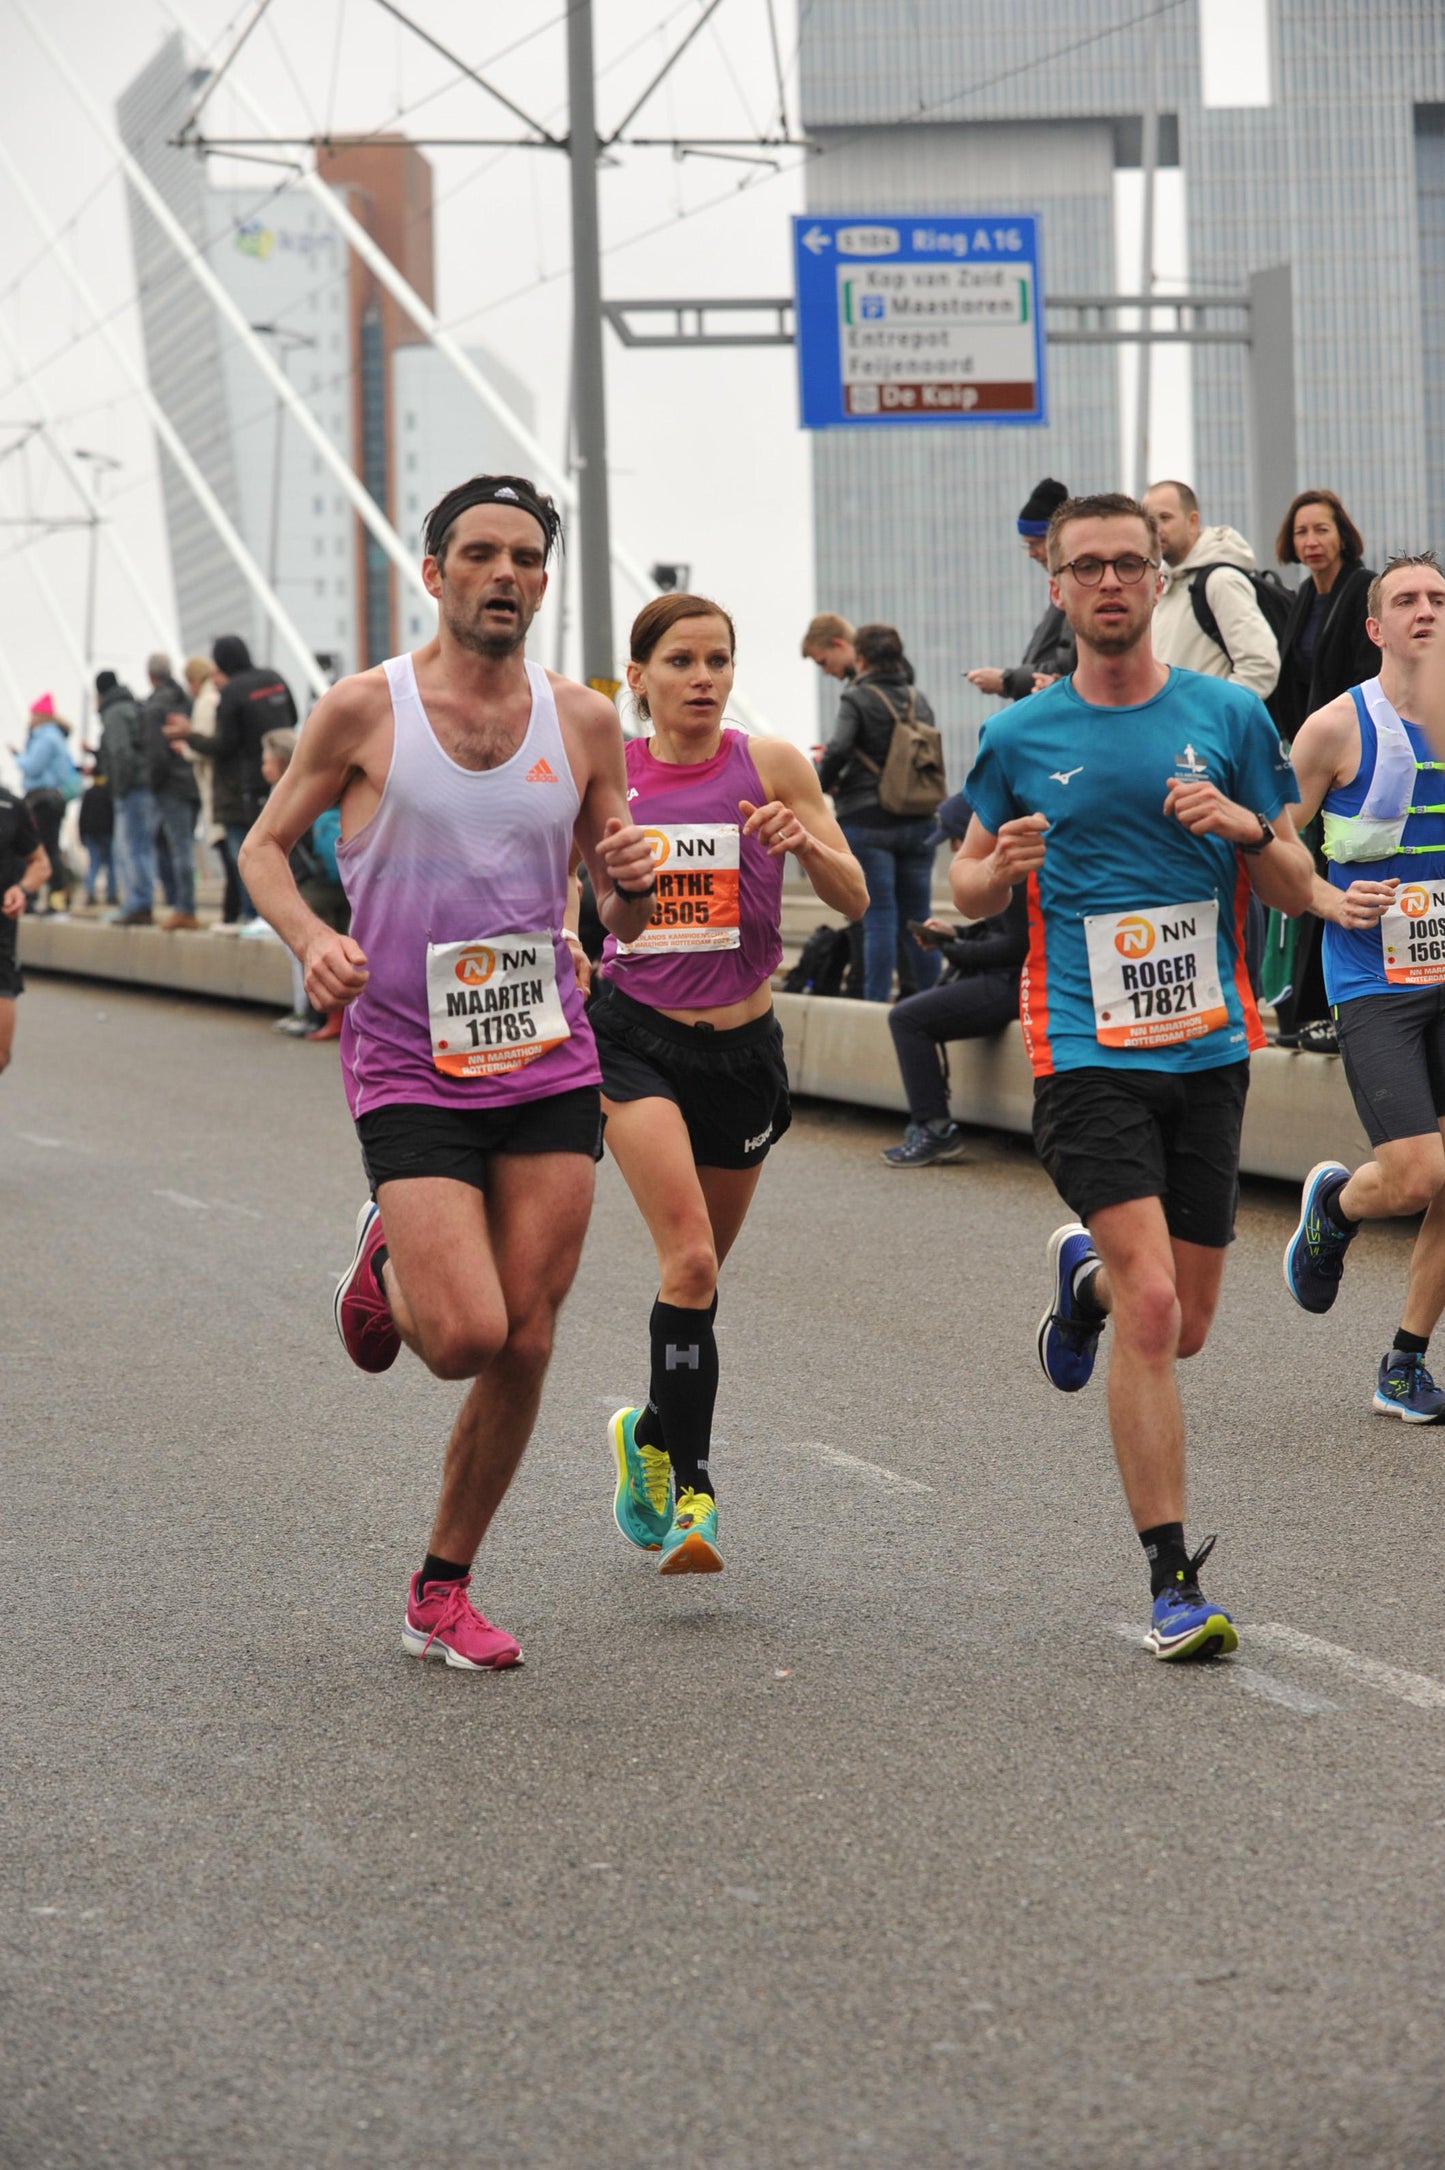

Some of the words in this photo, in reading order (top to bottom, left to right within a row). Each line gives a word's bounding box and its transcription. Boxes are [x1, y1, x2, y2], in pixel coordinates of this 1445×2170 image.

[912, 228, 968, 256] Ring
[867, 271, 906, 289] Kop
[913, 273, 949, 287] van
[958, 269, 1005, 287] Zuid
[891, 296, 1015, 315] Maastoren
[848, 330, 951, 350] Entrepot
[850, 353, 975, 379] Feijenoord
[882, 384, 916, 407] De
[921, 384, 979, 411] Kuip
[676, 839, 715, 857] NN
[655, 873, 714, 896] RTHE
[1161, 918, 1196, 943] NN
[502, 948, 536, 971] NN
[1121, 953, 1197, 991] ROGER
[446, 979, 544, 1017] MAARTEN
[1128, 982, 1197, 1019] 17821
[465, 1011, 537, 1047] 11785
[1131, 1026, 1147, 1036] NN
[1150, 1016, 1202, 1034] MARATHON
[1124, 1031, 1184, 1047] ROTTERDAM
[468, 1054, 484, 1065] NN
[487, 1045, 542, 1062] MARATHON
[462, 1059, 521, 1075] ROTTERDAM
